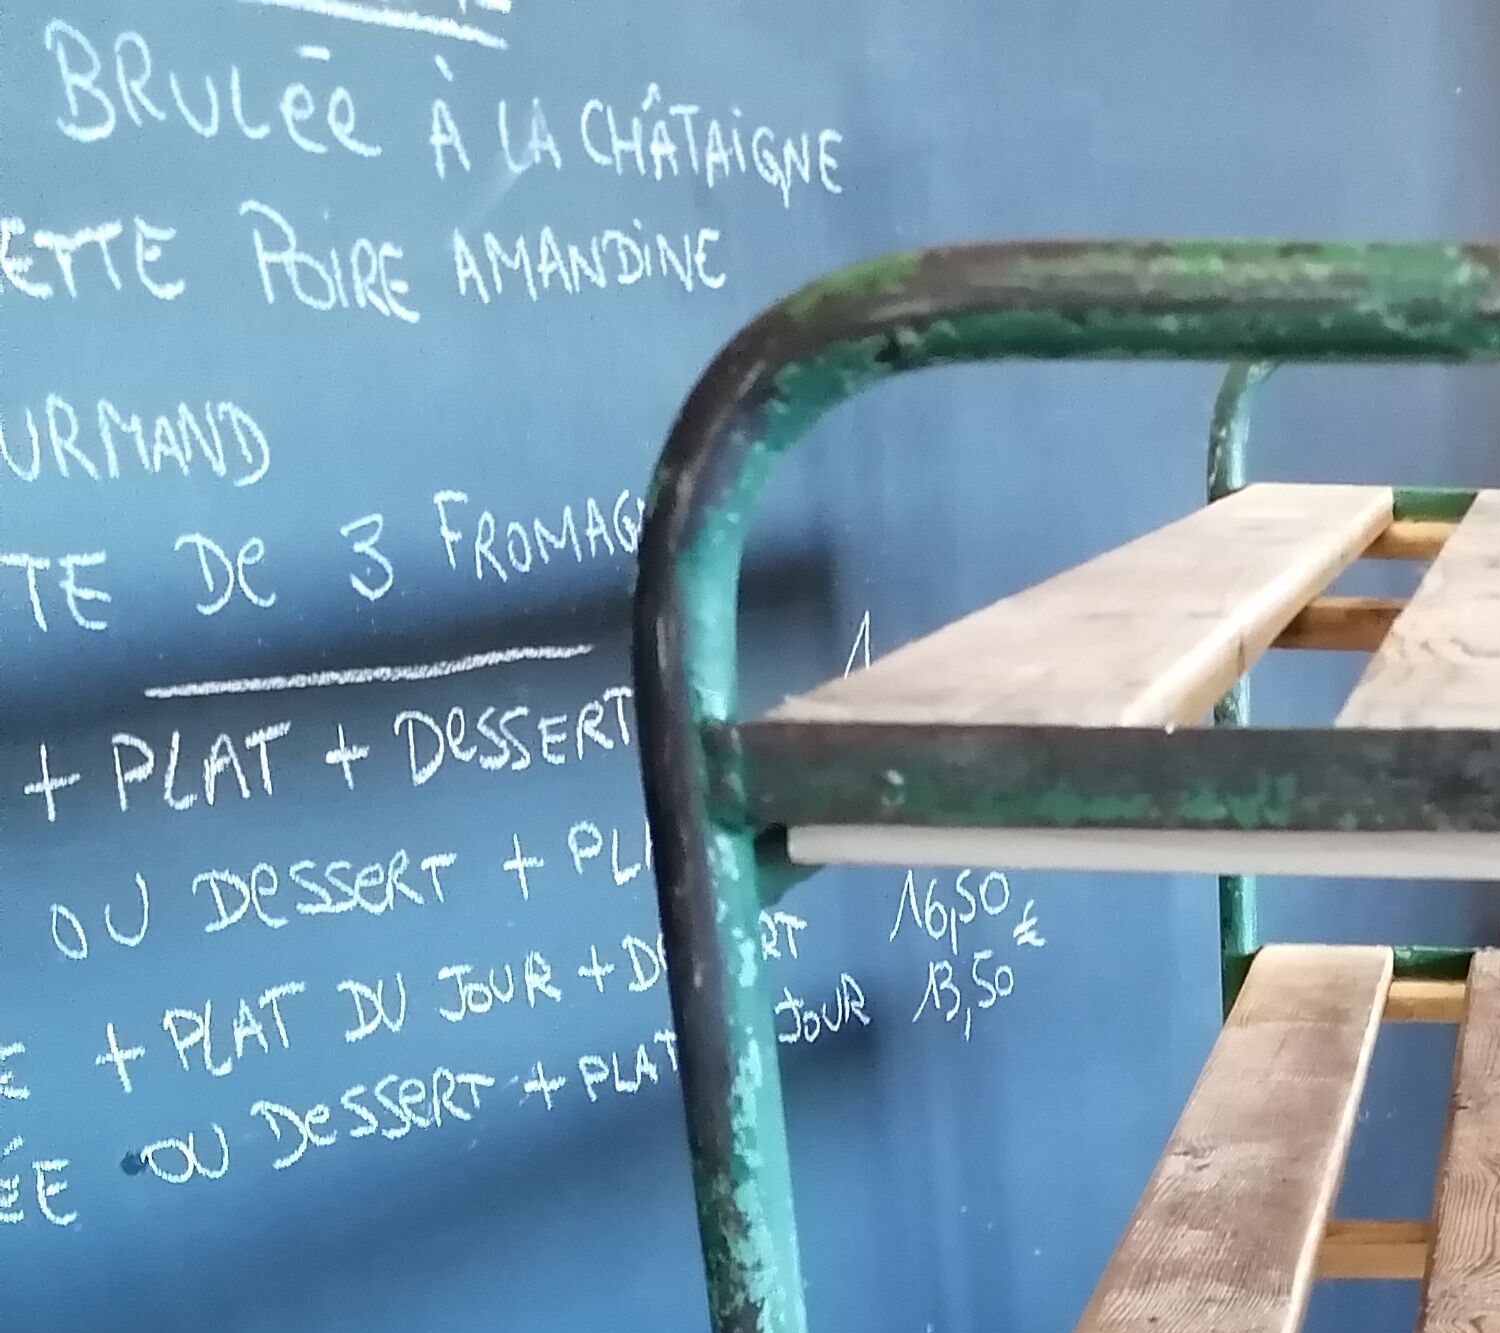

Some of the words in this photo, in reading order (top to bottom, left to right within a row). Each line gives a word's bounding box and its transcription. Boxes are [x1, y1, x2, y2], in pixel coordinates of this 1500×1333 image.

[499, 97, 562, 174] LA
[239, 199, 420, 324] POIRE
[340, 512, 393, 600] 3
[434, 489, 646, 583] FROMAG
[112, 720, 291, 811] PLAT
[51, 872, 149, 960] OU
[163, 980, 305, 1077] PLAT
[336, 973, 407, 1042] DU
[438, 951, 562, 1022] JOUR
[141, 1121, 229, 1183] OU
[578, 1029, 679, 1102] PLAT
